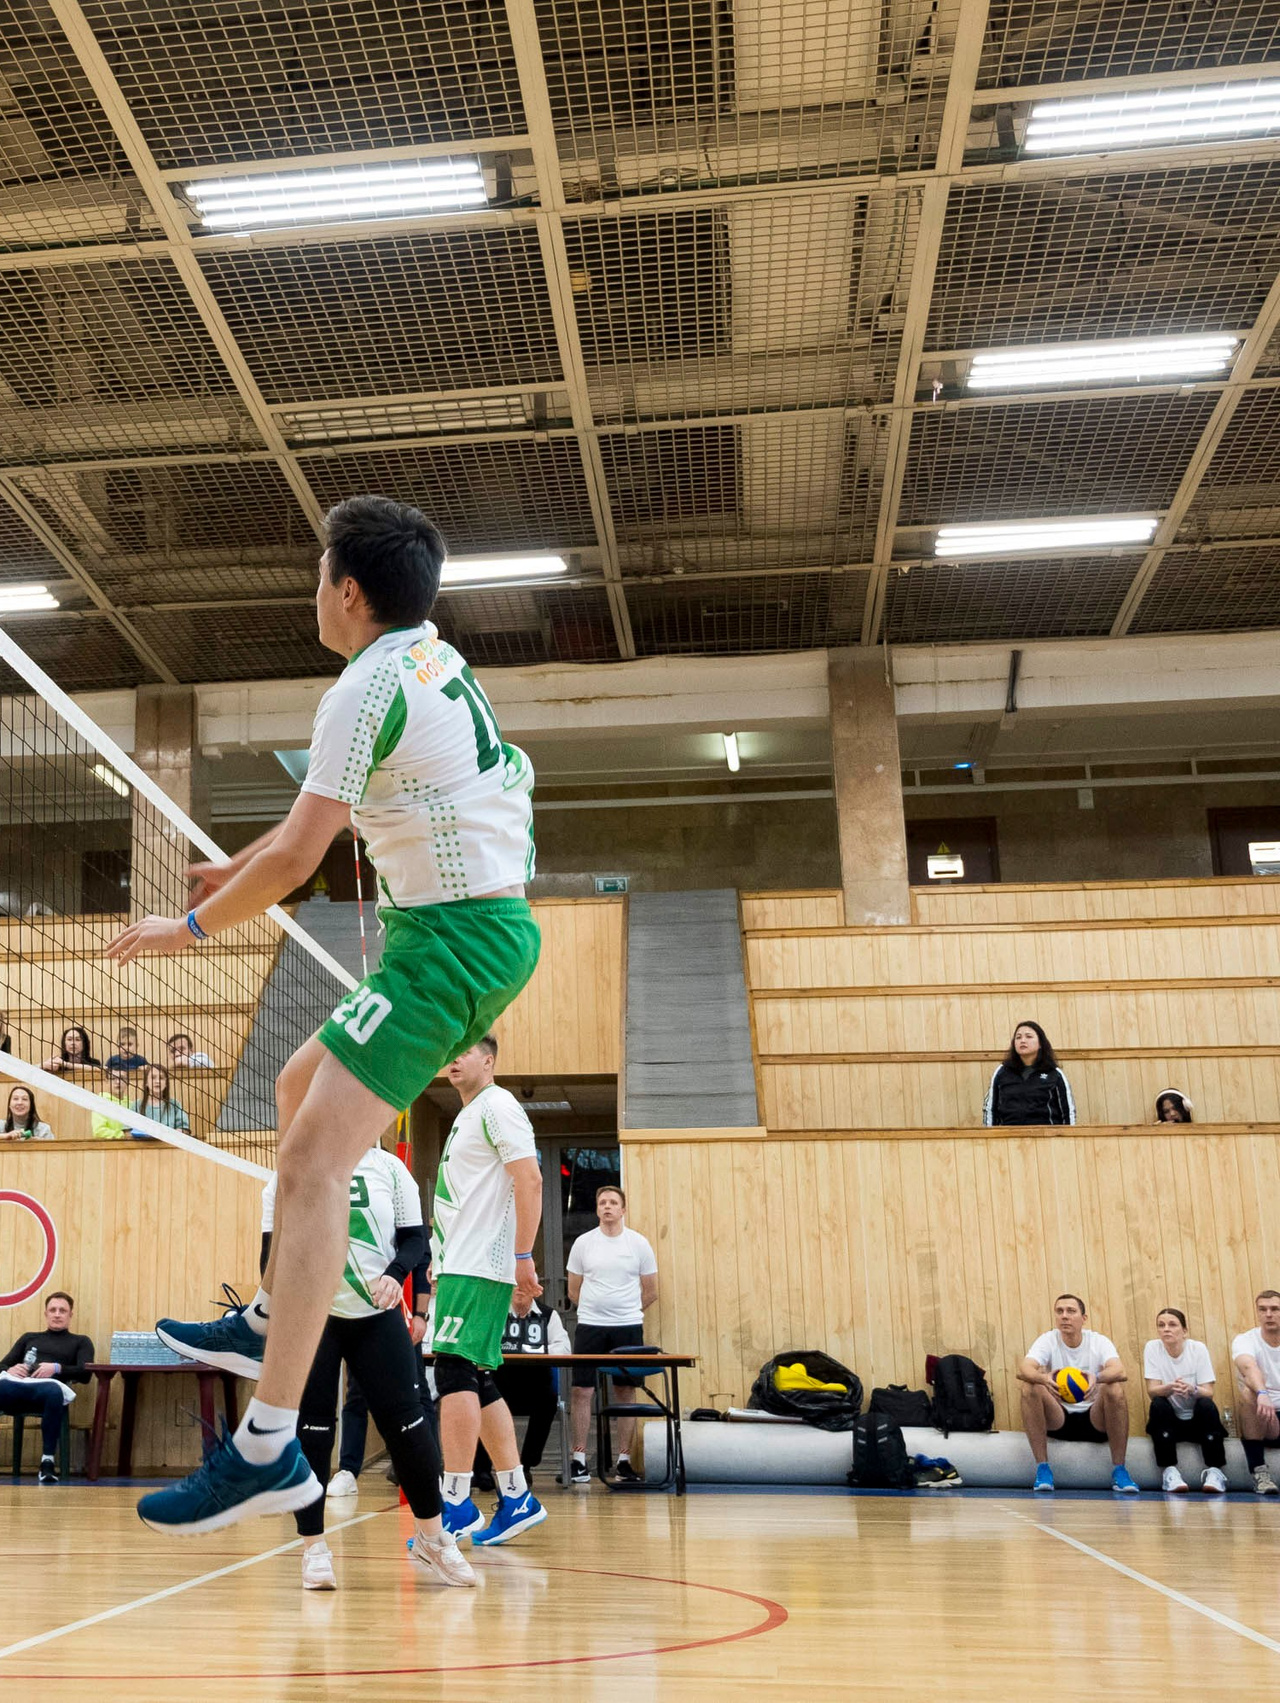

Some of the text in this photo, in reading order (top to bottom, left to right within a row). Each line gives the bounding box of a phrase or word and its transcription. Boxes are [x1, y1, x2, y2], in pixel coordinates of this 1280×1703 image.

[331, 985, 392, 1045] 20
[434, 1316, 464, 1343] 22
[509, 1322, 542, 1343] 0 9
